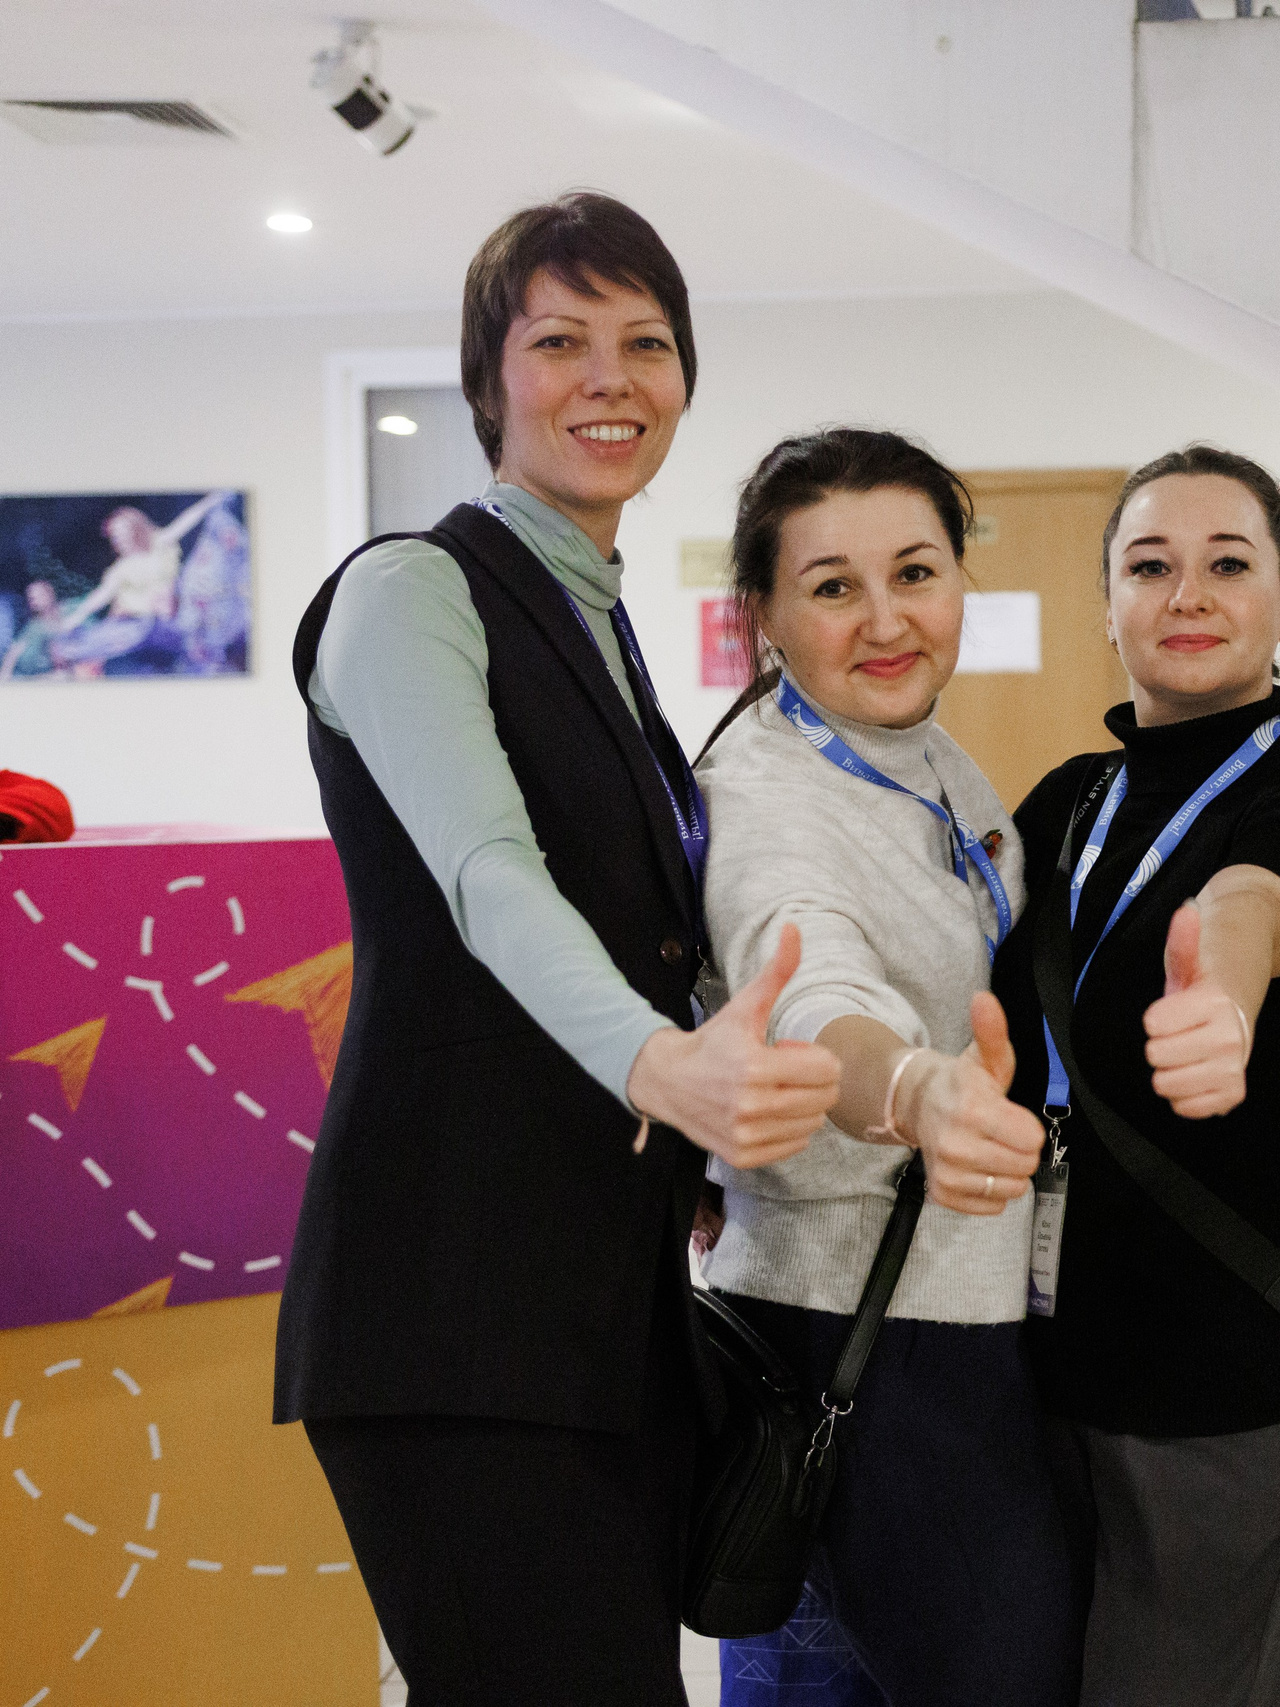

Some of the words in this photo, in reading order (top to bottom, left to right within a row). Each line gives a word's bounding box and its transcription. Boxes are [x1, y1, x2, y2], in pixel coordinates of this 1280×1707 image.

[1088, 766, 1114, 800] STYLE
[1208, 759, 1246, 790] Виват,
[1098, 791, 1124, 826] Виват,
[1169, 790, 1215, 838] таланты!
